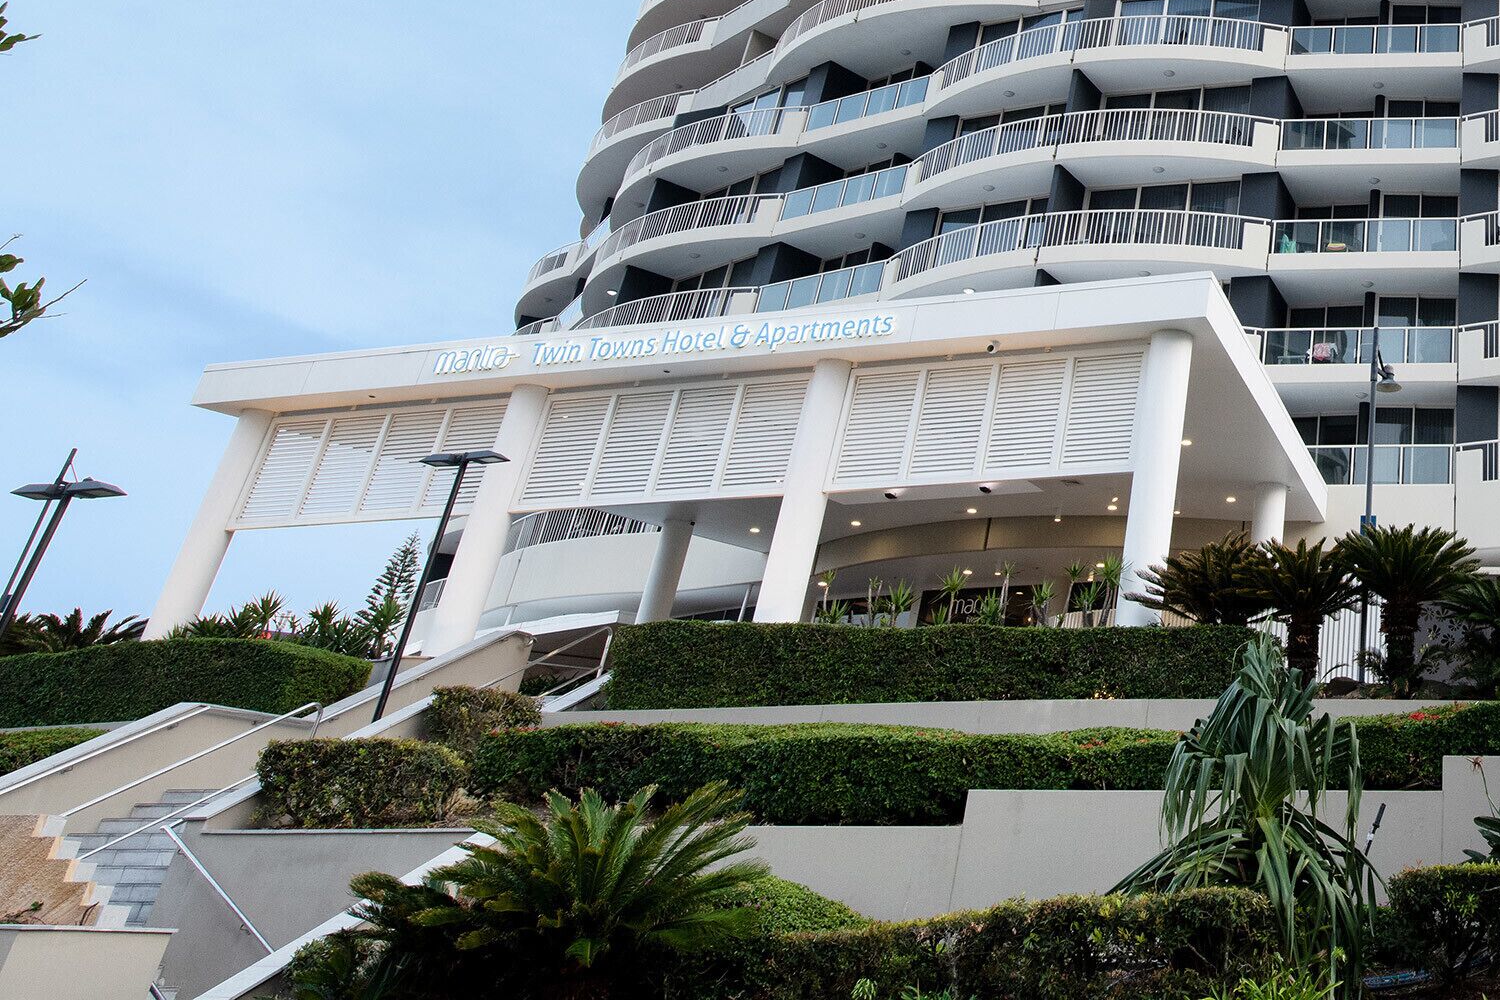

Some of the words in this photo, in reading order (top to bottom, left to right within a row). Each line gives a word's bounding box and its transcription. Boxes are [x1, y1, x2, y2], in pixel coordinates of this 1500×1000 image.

[433, 343, 520, 375] mantra
[532, 339, 584, 366] Twin
[589, 335, 659, 361] Towns
[661, 325, 725, 354] Hotel
[729, 324, 751, 350] &
[753, 314, 896, 353] Apartments
